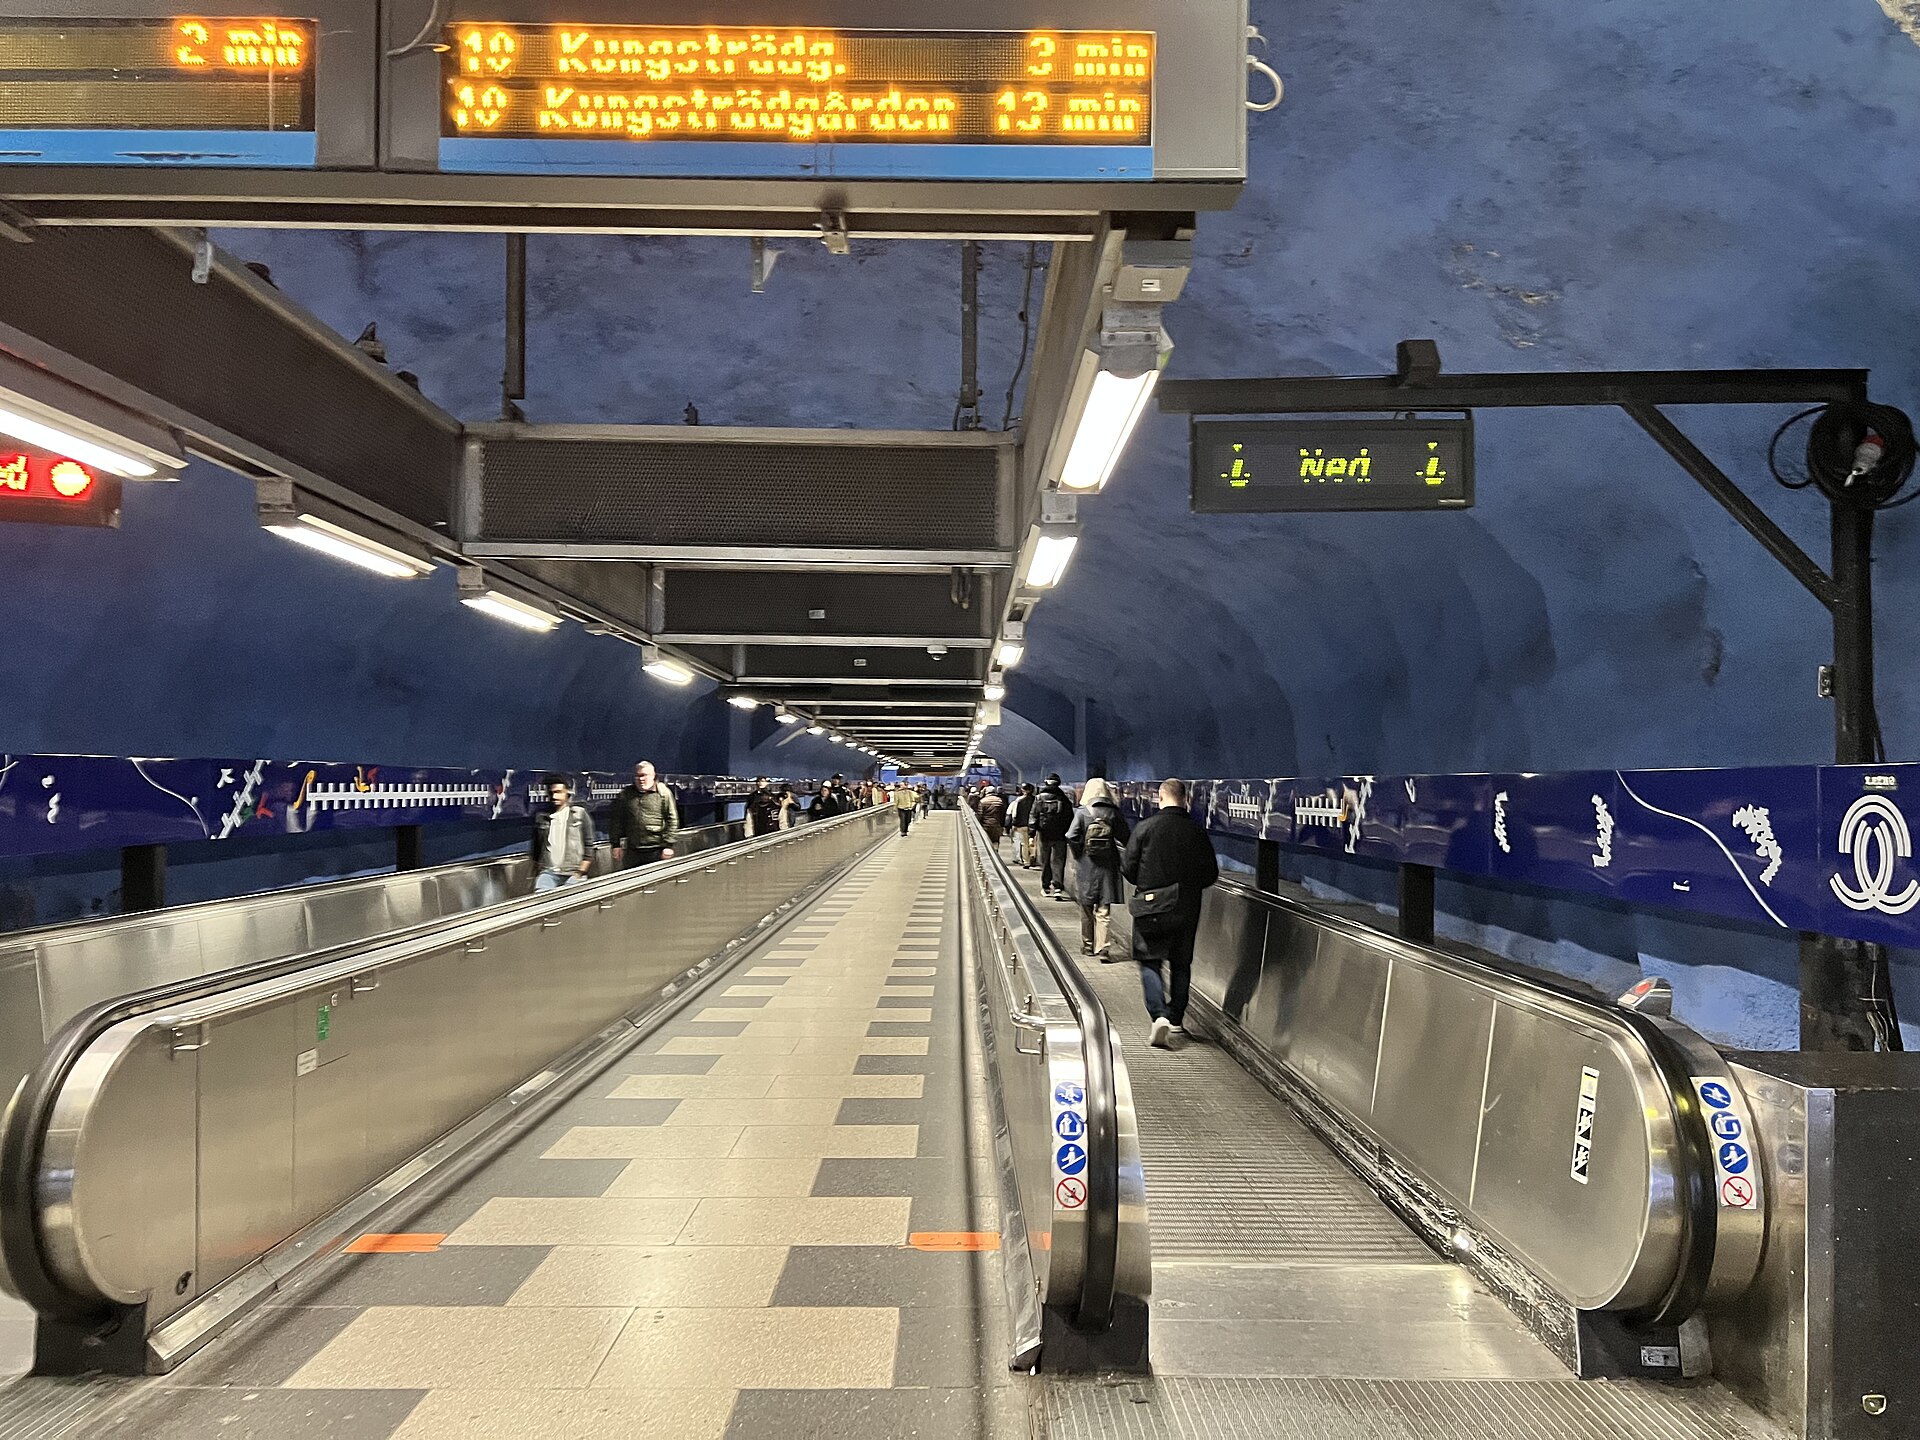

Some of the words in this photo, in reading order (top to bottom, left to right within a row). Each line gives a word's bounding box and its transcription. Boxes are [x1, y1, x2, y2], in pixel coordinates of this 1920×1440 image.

[176, 22, 209, 66] 2
[222, 22, 304, 67] min
[464, 31, 517, 74] 10
[1073, 37, 1148, 77] min
[1061, 91, 1142, 132] min
